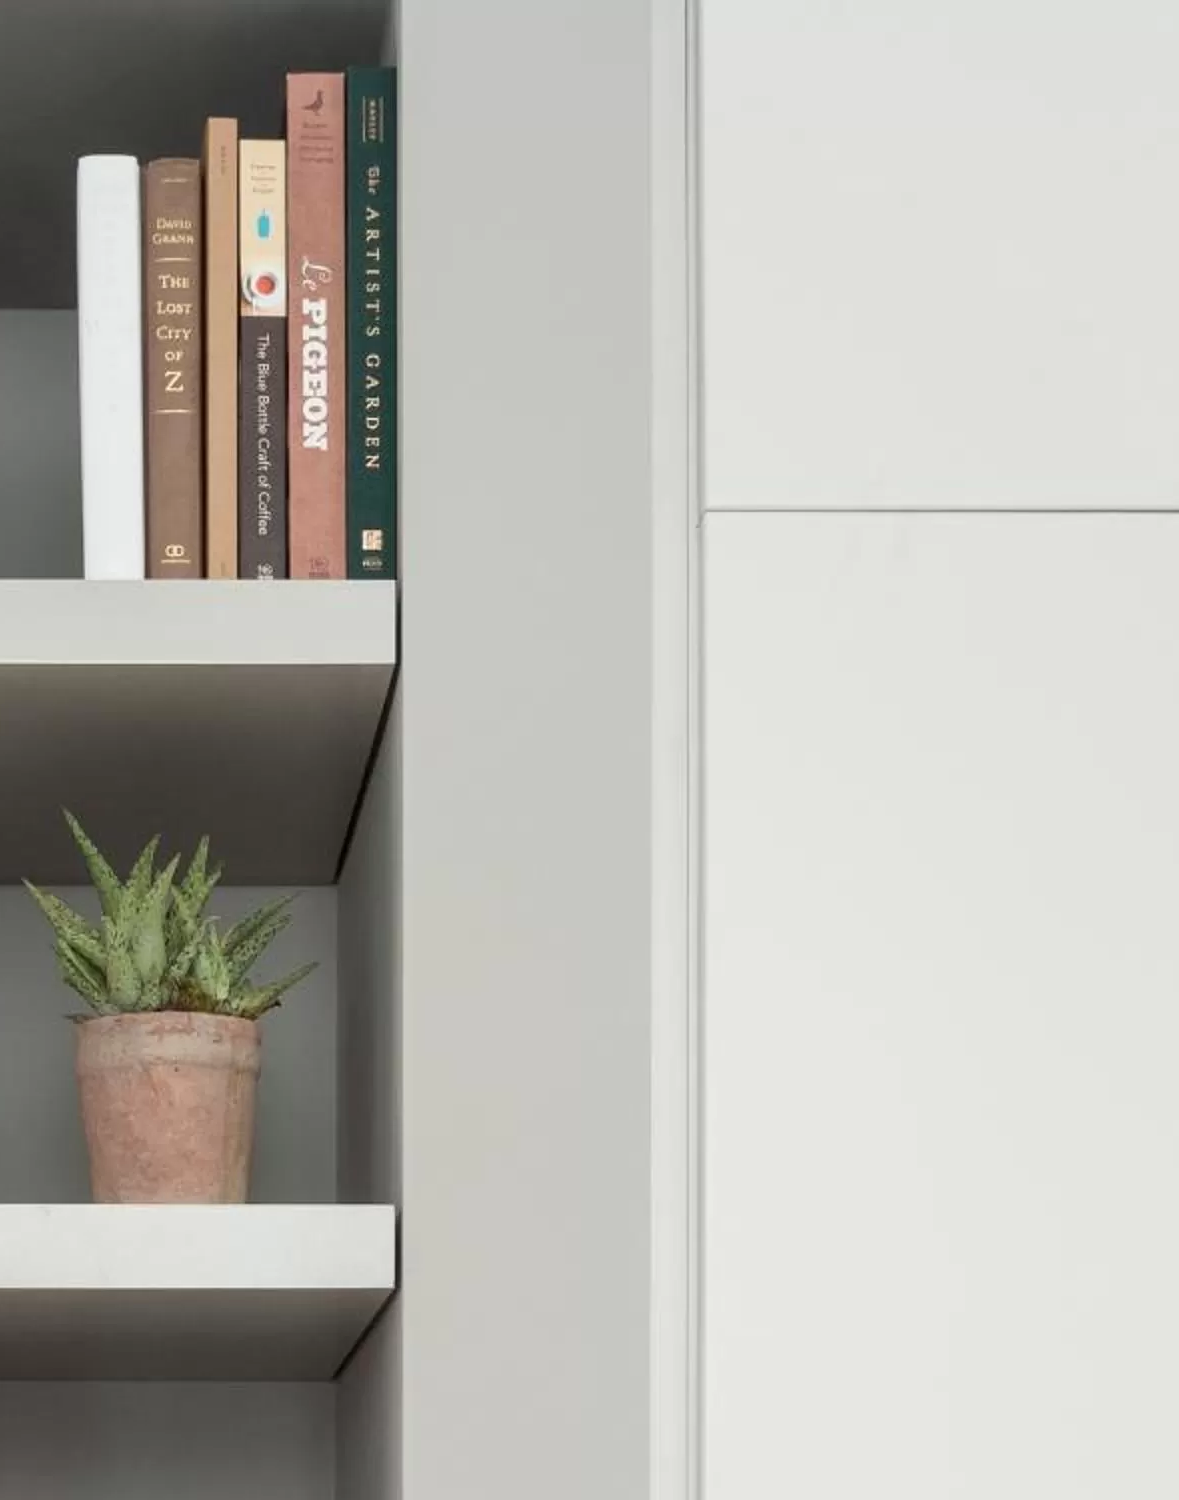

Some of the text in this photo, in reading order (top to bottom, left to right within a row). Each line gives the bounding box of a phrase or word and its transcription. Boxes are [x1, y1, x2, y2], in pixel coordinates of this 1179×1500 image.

[158, 273, 191, 289] THE
[365, 205, 381, 338] ARTIST'S
[156, 300, 193, 315] LOST
[156, 325, 193, 341] CITY
[164, 370, 185, 393] Z
[301, 255, 334, 452] Le PIGEON
[256, 332, 272, 536] The Blue Bottle Craft of Coffee
[365, 353, 381, 470] GARDEN
